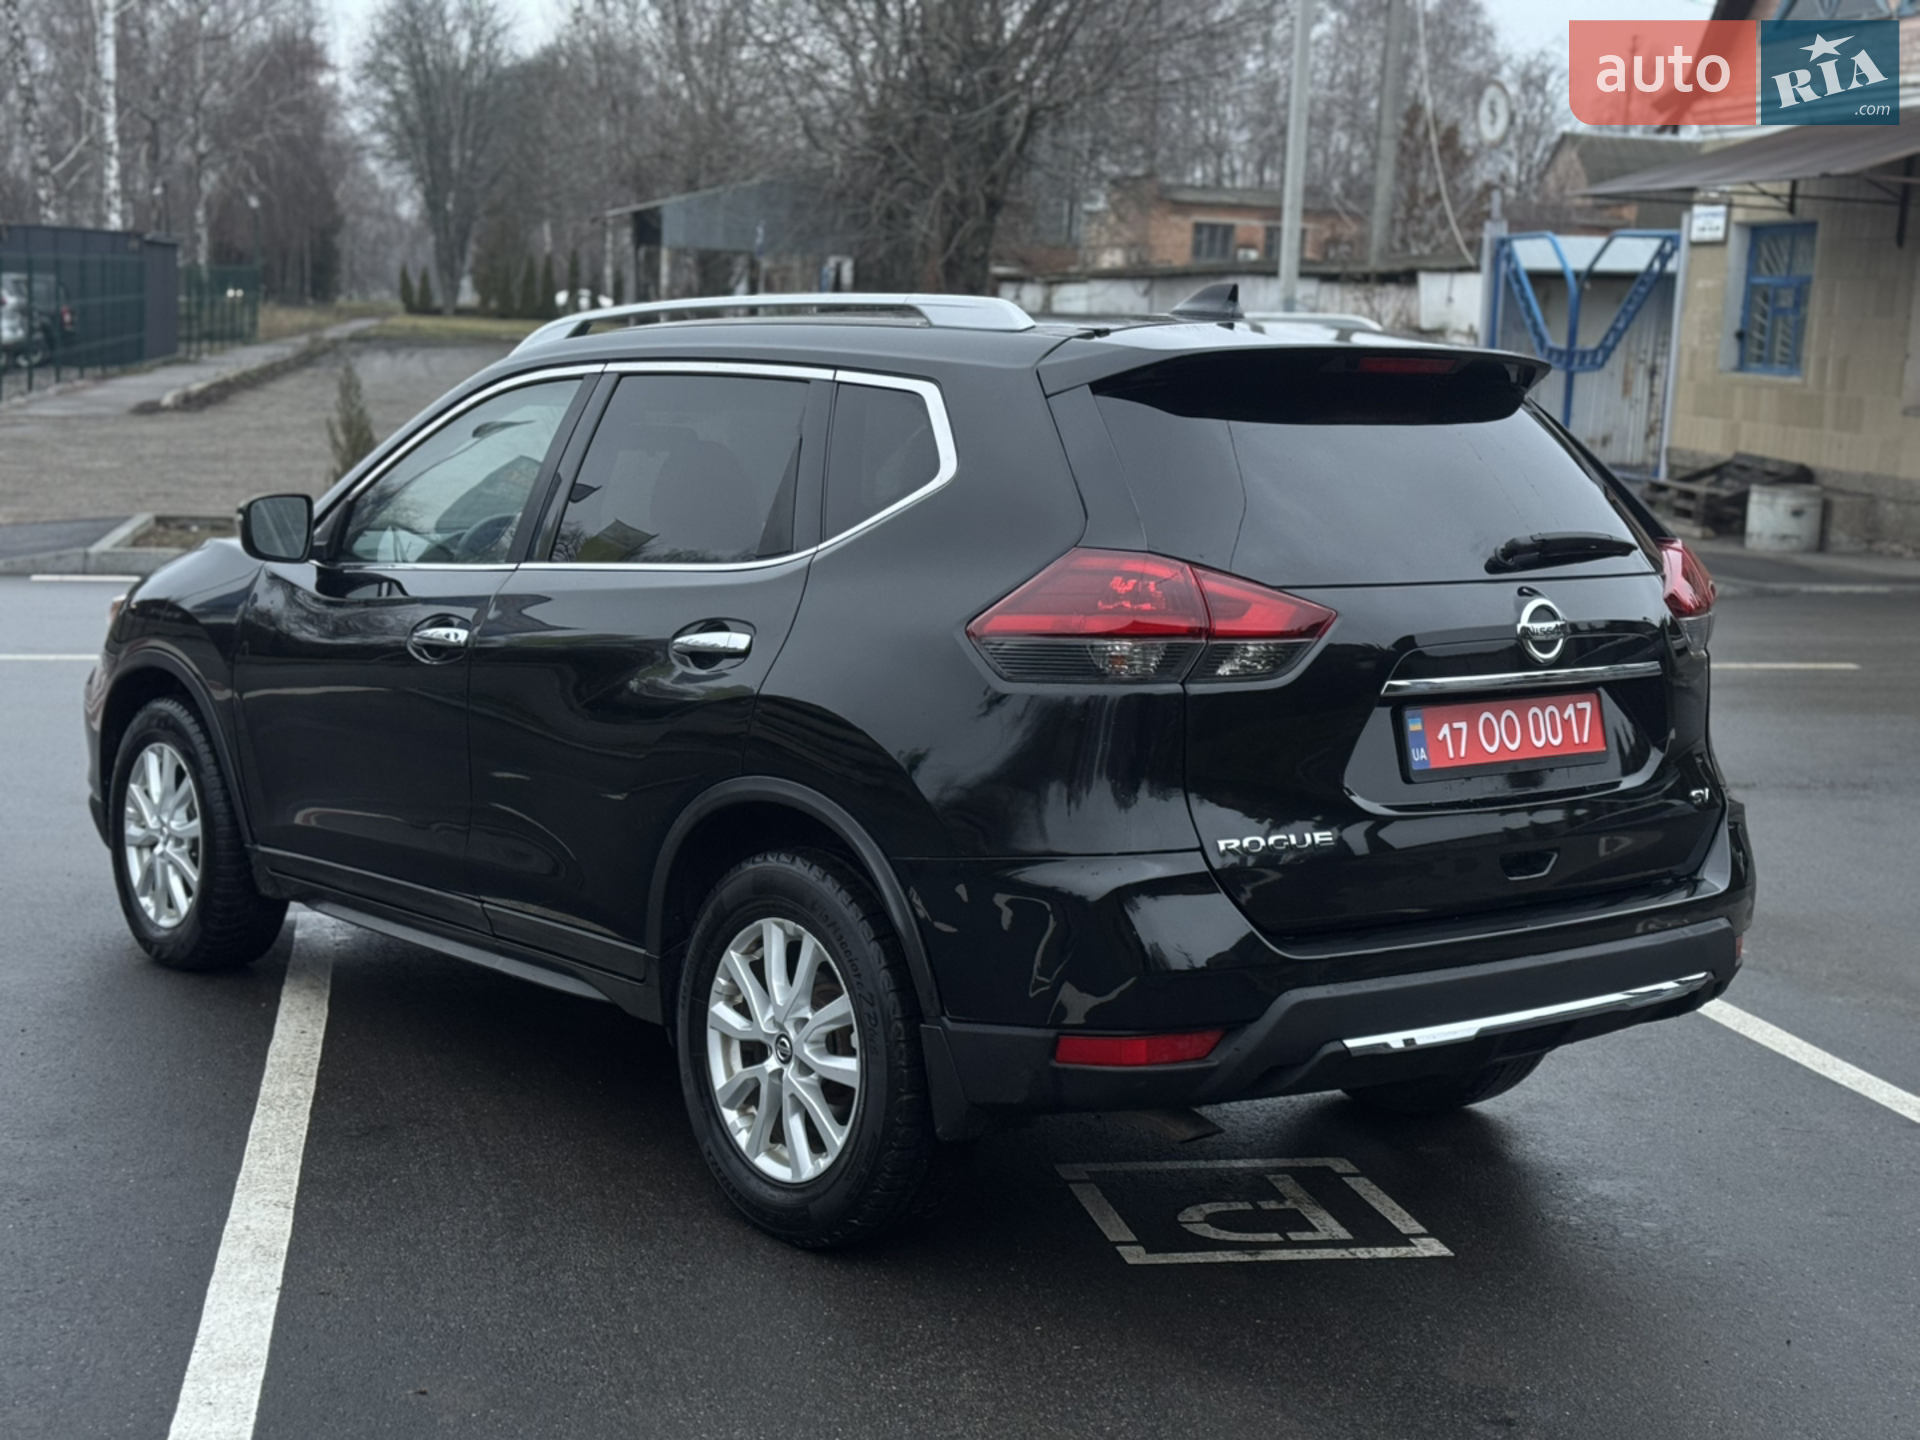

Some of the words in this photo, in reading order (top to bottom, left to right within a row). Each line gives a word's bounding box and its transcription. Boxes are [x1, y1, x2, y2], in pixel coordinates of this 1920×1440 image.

[1437, 721, 1468, 759] 17
[1527, 701, 1592, 748] 0017
[1412, 747, 1428, 761] UA
[1217, 831, 1335, 855] ROGUE
